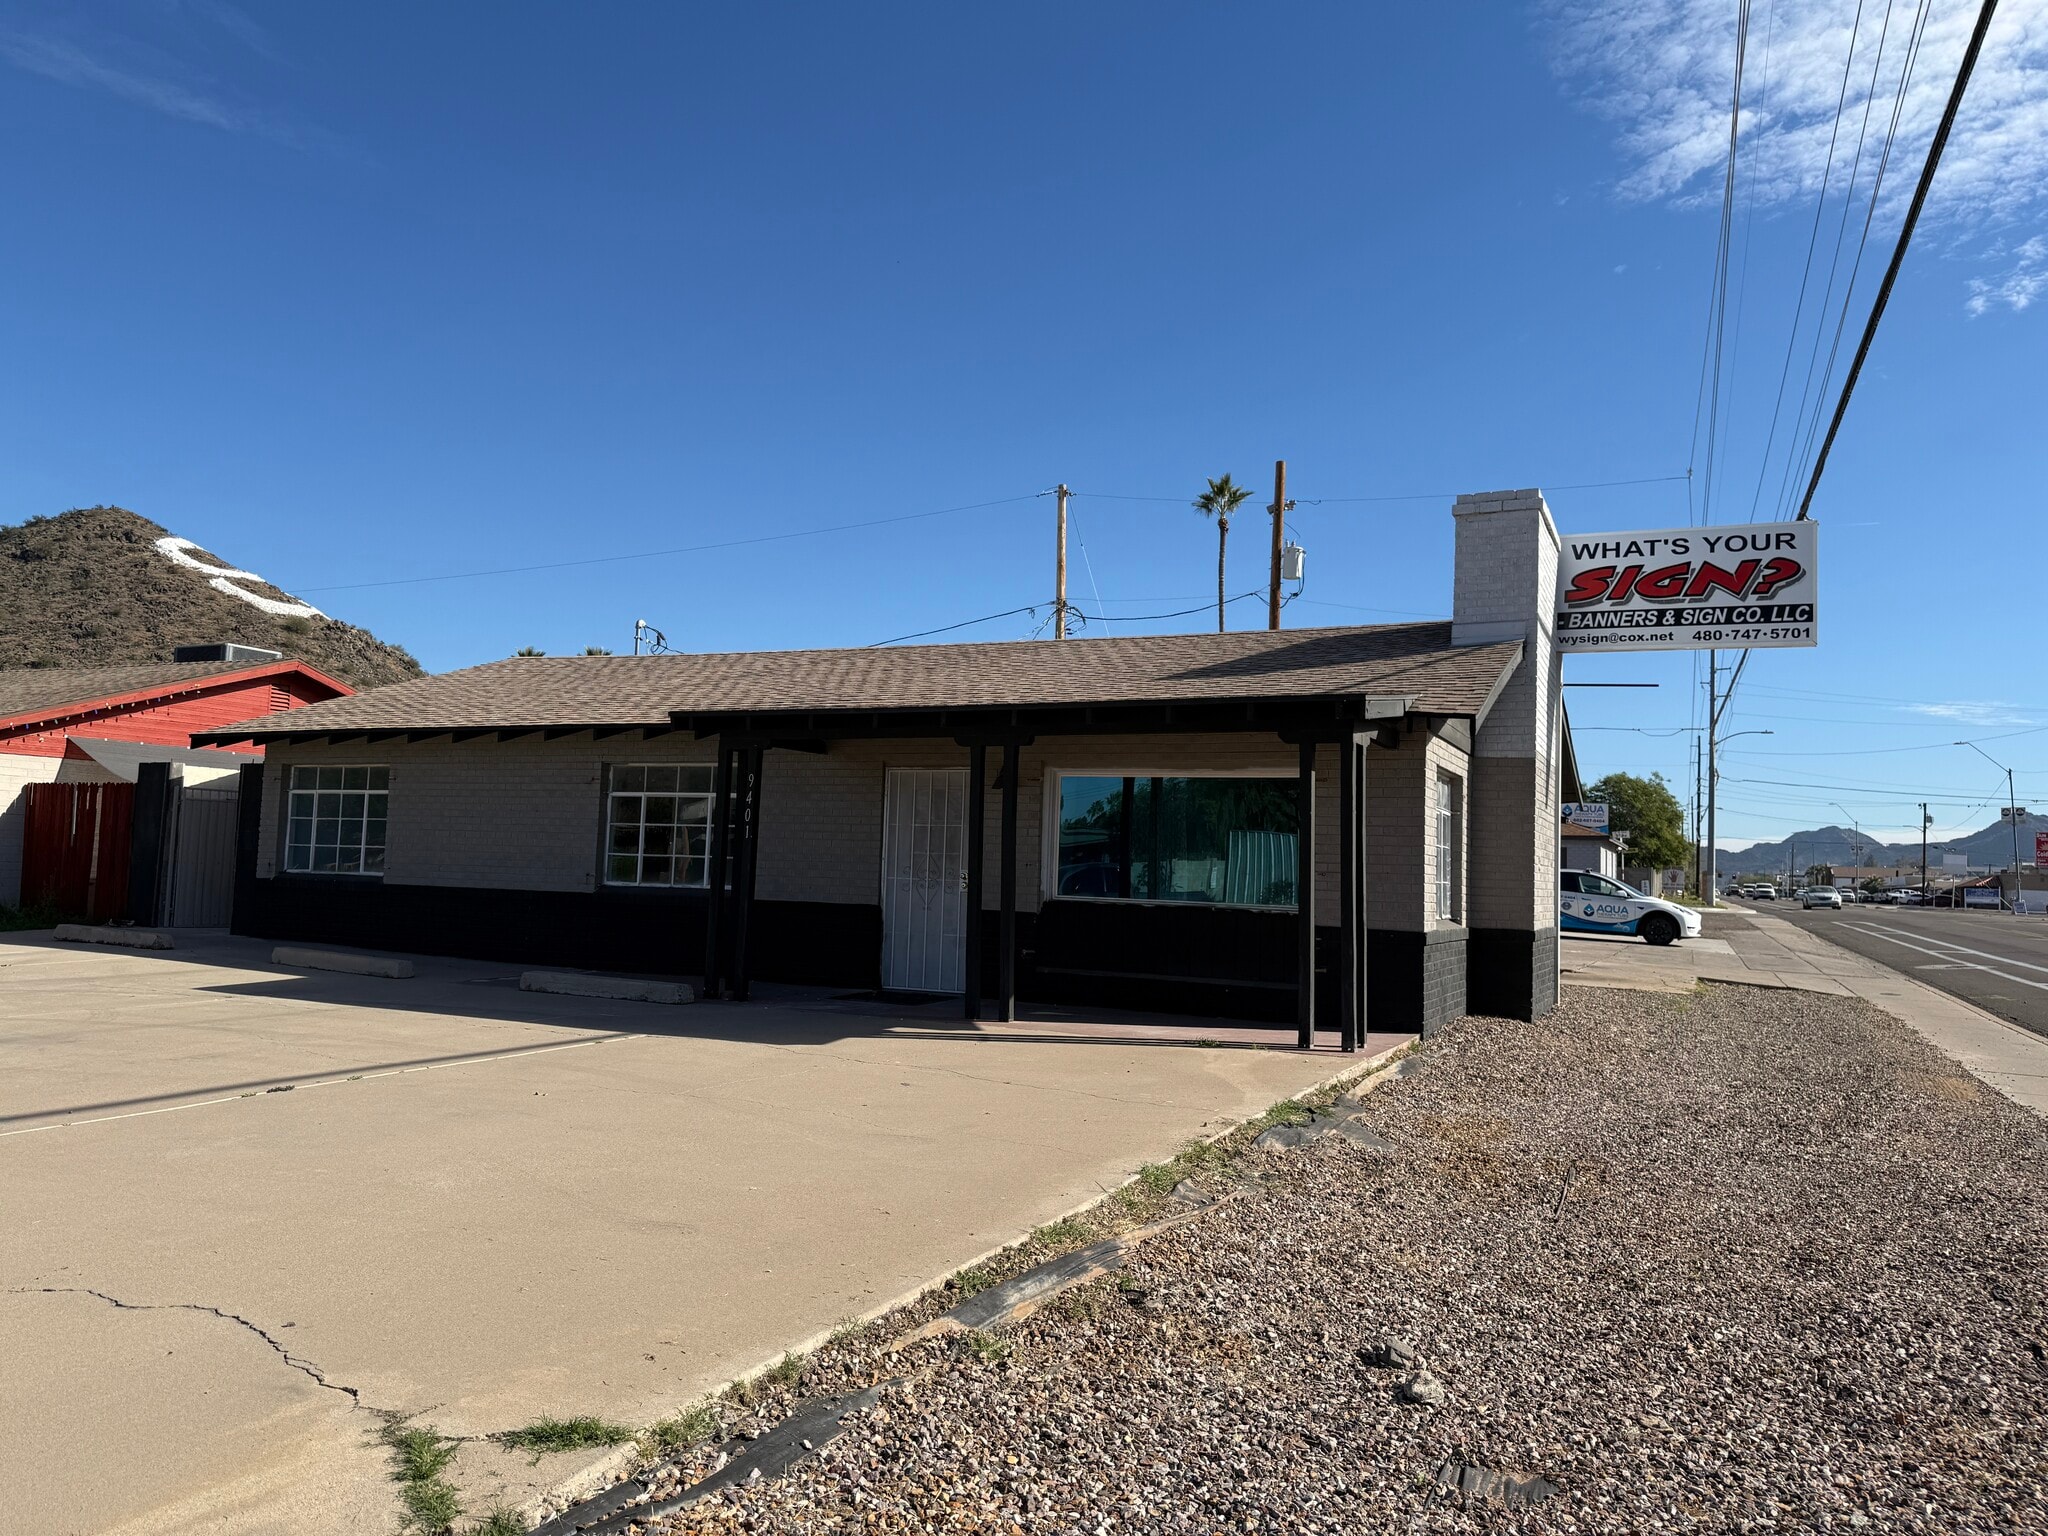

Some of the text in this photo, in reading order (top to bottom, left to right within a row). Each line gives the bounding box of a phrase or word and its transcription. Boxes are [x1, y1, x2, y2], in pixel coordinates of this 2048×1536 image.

[1571, 533, 1798, 560] WHAT'S YOUR
[1564, 557, 1806, 608] SIGN?
[1568, 610, 1658, 628] BANNERS
[1662, 609, 1676, 625] &
[1681, 608, 1728, 625] SIGN
[1732, 607, 1764, 623] CO.
[1771, 605, 1810, 622] LLC
[1558, 632, 1674, 646] wysign@cox.net
[745, 773, 755, 839] 9401
[1574, 804, 1605, 814] AQUA
[1596, 904, 1629, 914] AQUA
